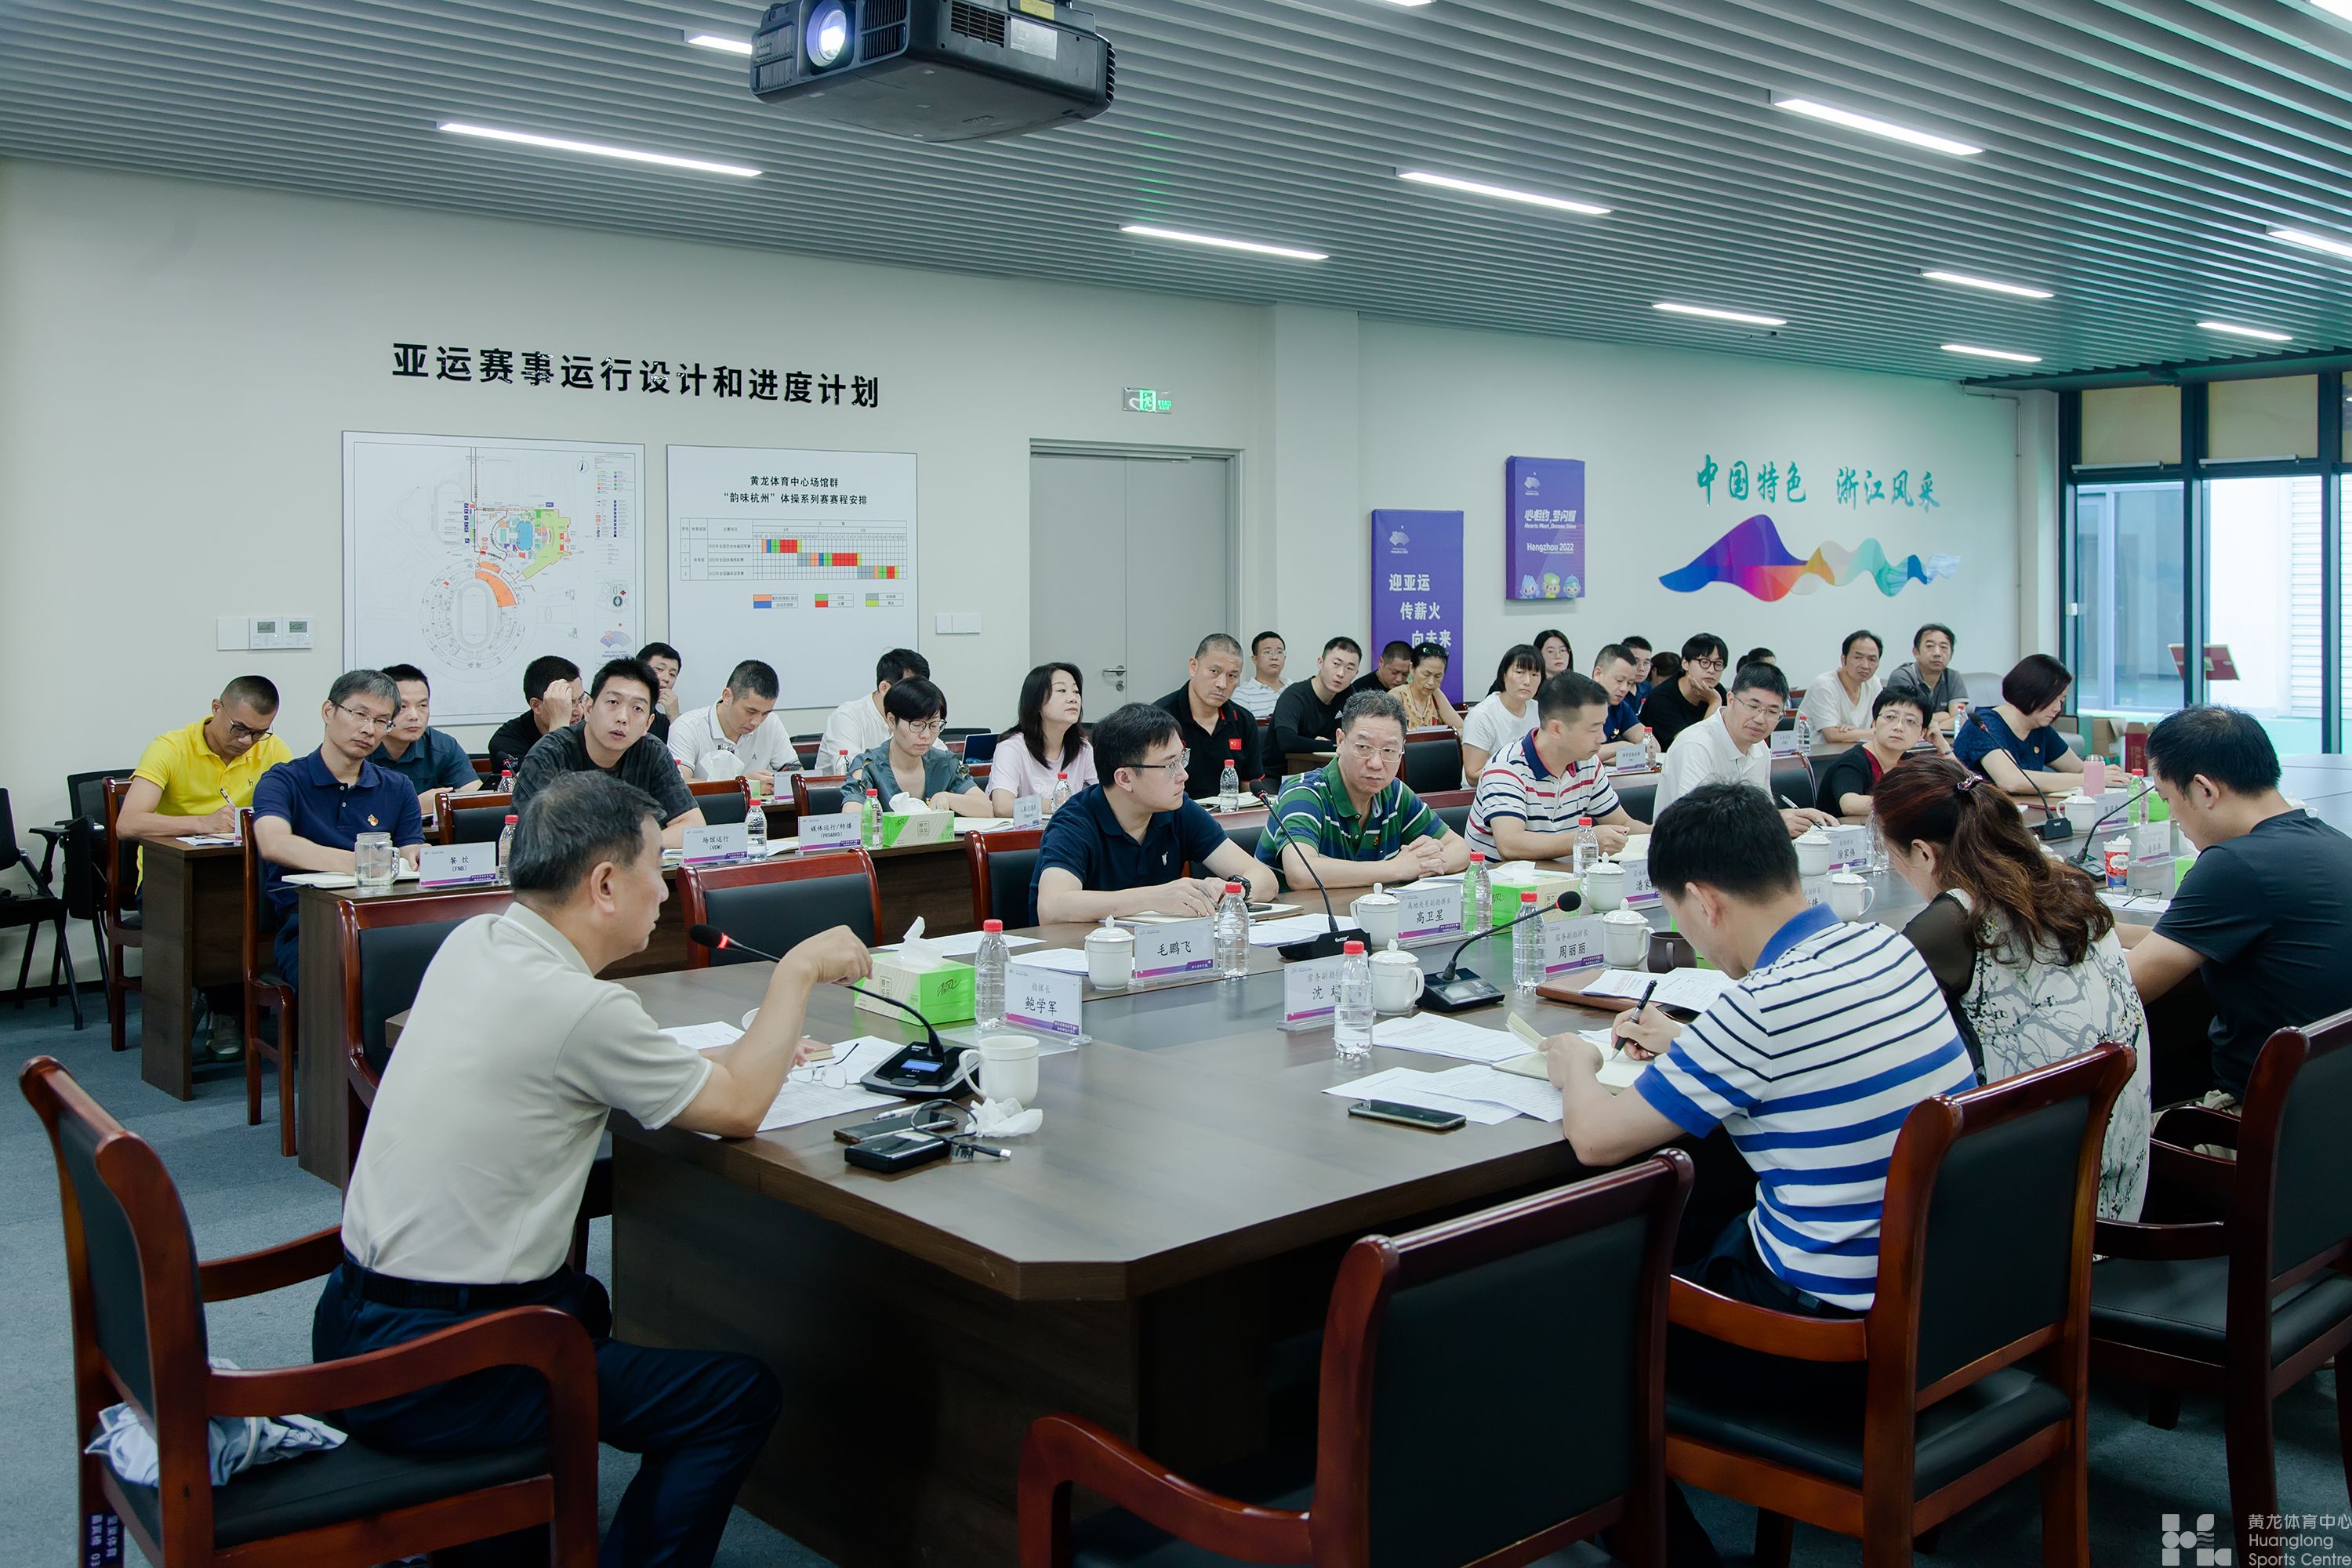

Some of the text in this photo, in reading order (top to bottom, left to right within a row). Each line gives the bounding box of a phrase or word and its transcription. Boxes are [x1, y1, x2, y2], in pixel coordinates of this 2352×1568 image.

[392, 342, 880, 408] 亚运赛事运行设计和进度计划
[750, 476, 839, 488] 黄龙体育中心场馆群
[1697, 454, 1940, 514] 中国特色 浙江风采
[1526, 543, 1574, 552] Hangzhou 2022
[1388, 573, 1430, 592] 迎亚运
[1400, 601, 1441, 621] 传薪火
[1417, 909, 1444, 924] 高卫星
[1157, 941, 1192, 956] 毛鹏飞
[1559, 942, 1586, 960] 周丽丽
[1025, 996, 1058, 1016] 鲍学军
